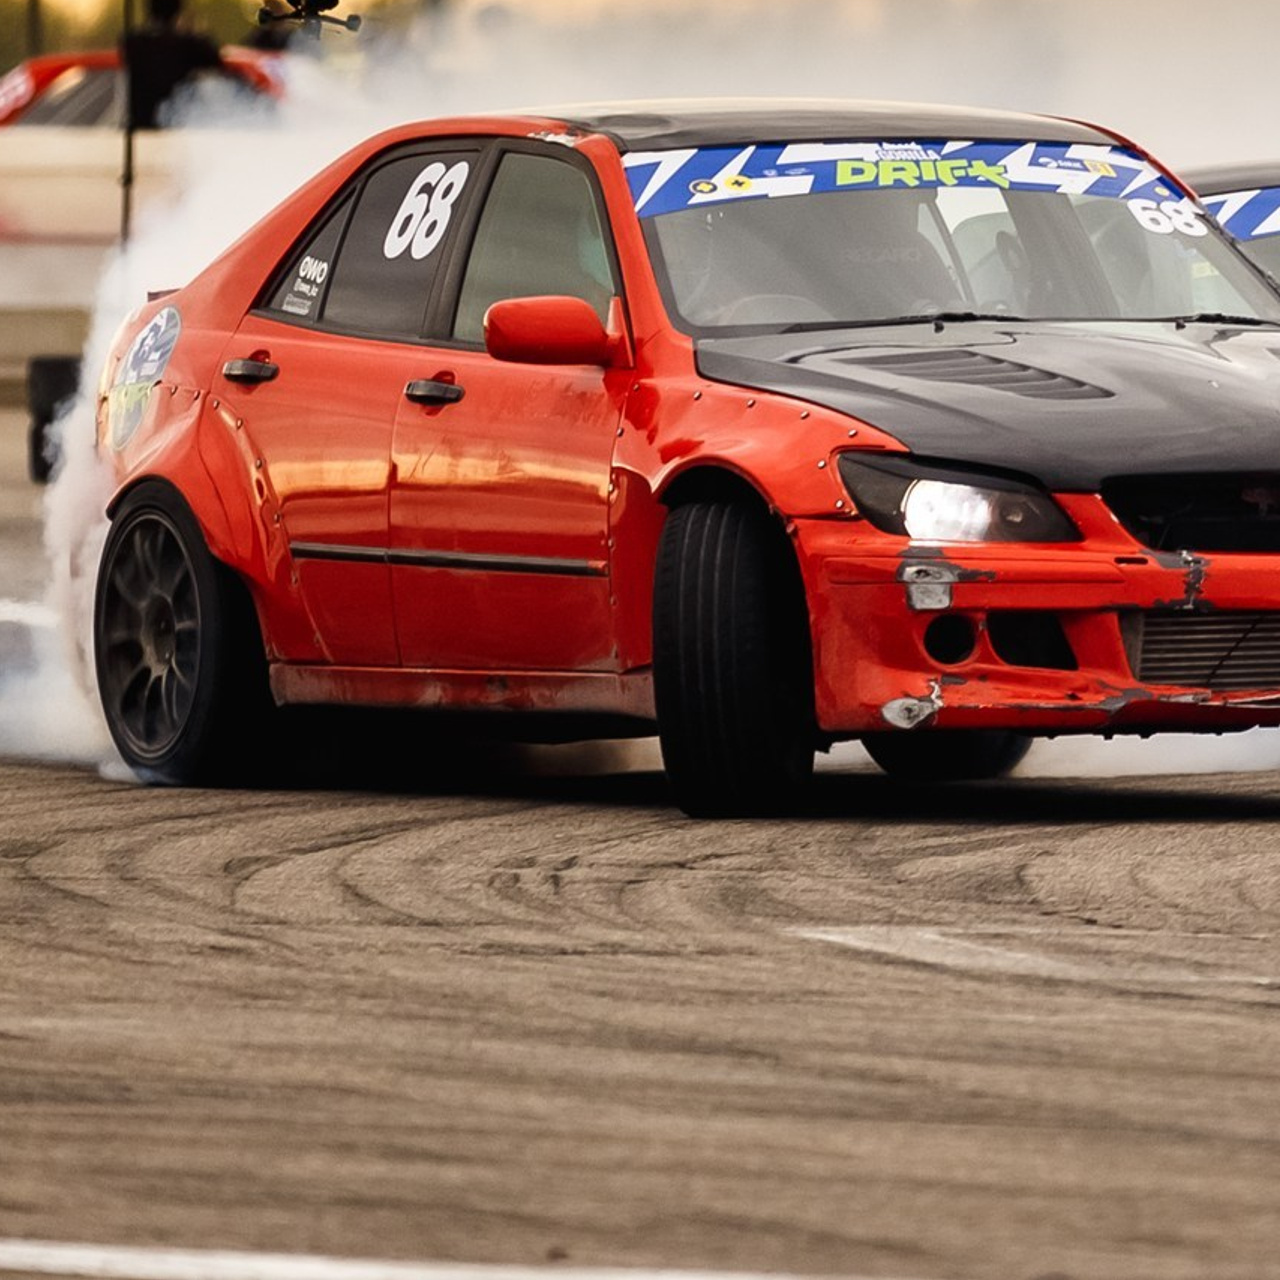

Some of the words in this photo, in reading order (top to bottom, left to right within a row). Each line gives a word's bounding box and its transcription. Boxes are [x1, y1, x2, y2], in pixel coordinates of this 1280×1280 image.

[836, 159, 1010, 189] DRIFT
[383, 161, 469, 260] 68
[1127, 198, 1208, 237] 68
[299, 256, 328, 284] OWO
